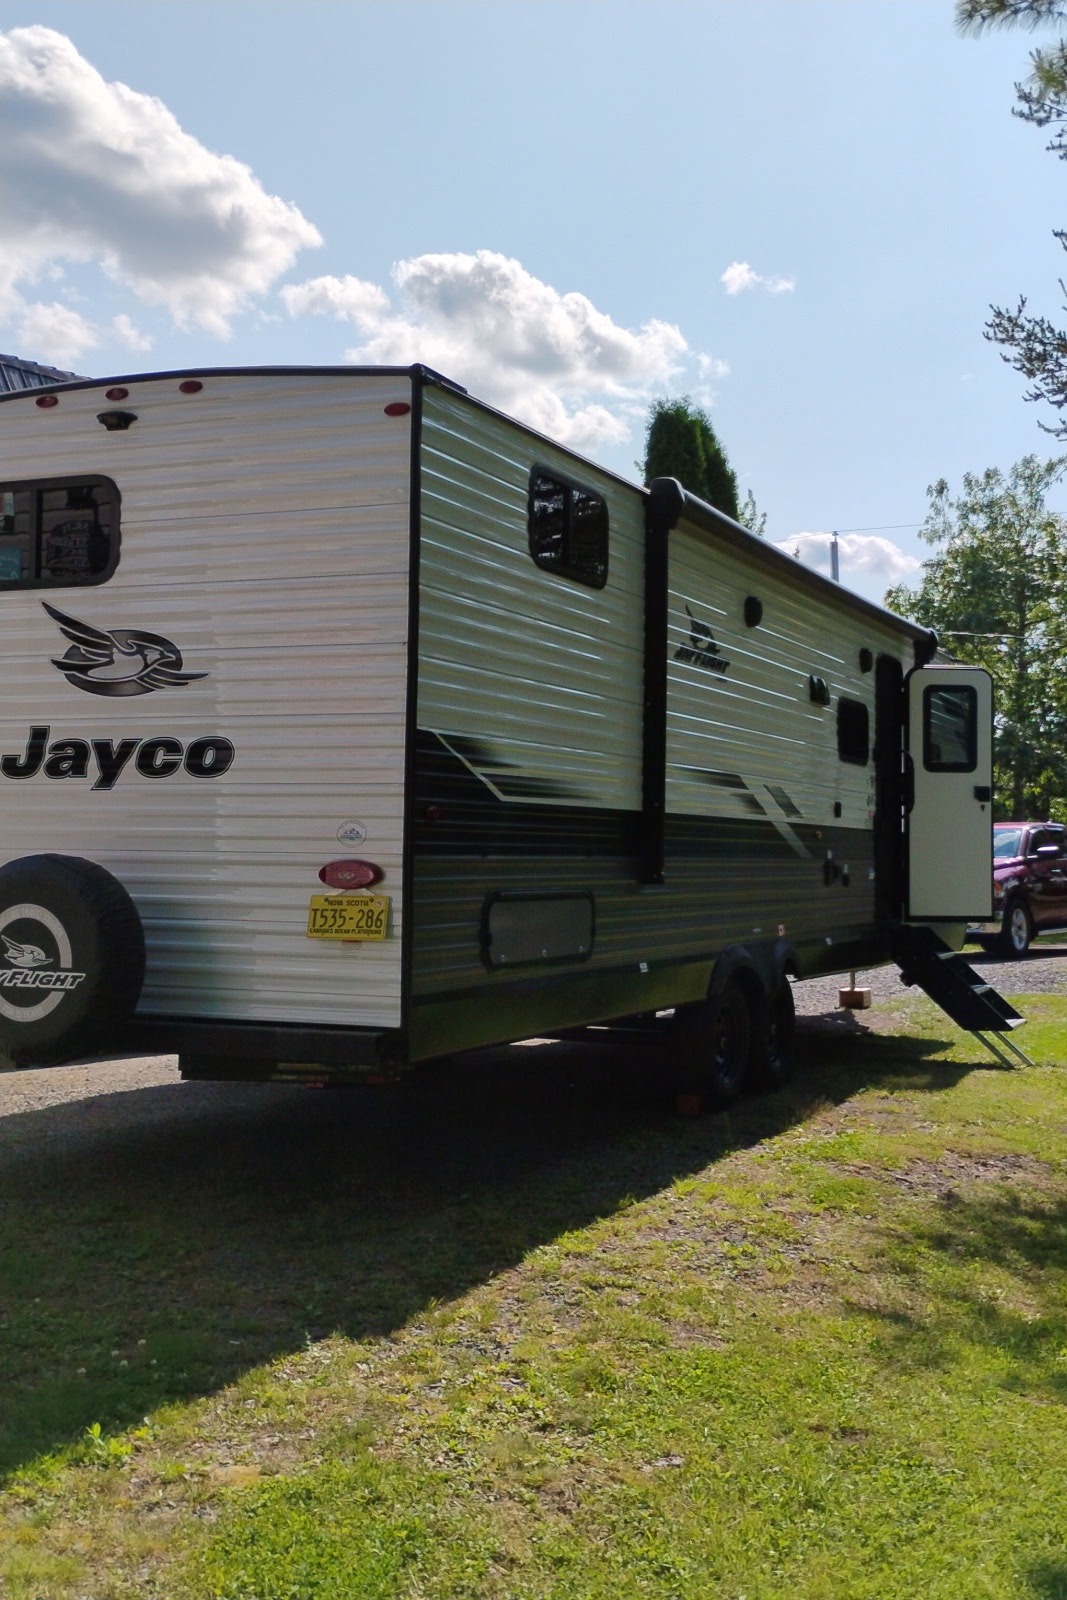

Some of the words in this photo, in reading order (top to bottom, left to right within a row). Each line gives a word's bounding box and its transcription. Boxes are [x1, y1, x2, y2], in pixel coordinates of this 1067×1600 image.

[693, 652, 731, 673] FLIGHT
[1, 725, 235, 790] Jayco
[311, 908, 385, 928] T535-286
